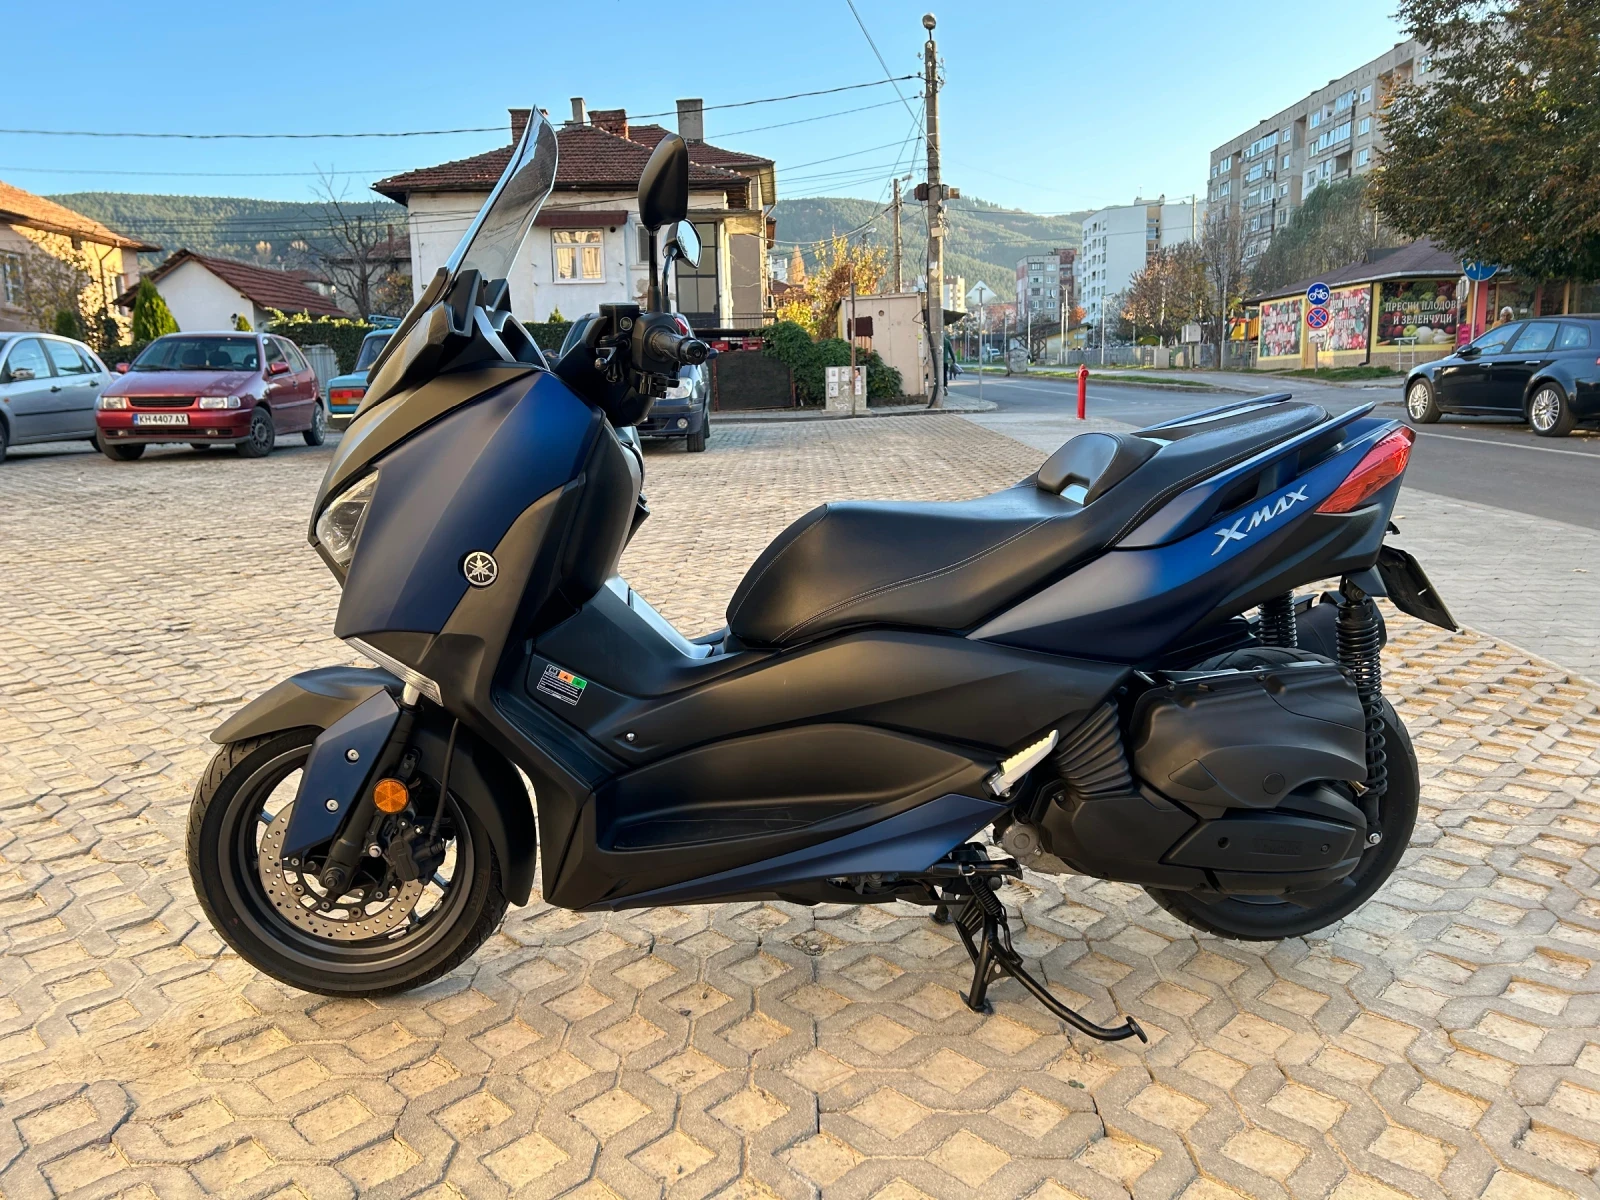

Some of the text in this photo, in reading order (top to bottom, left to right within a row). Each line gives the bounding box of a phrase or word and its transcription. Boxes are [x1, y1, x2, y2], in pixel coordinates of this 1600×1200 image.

[1385, 300, 1461, 312] ПРЕСНИ ПЛОДОВ
[1393, 313, 1453, 325] И ЗЕЛЕНЧУЦИ
[153, 415, 172, 424] 4407
[175, 415, 186, 424] AX
